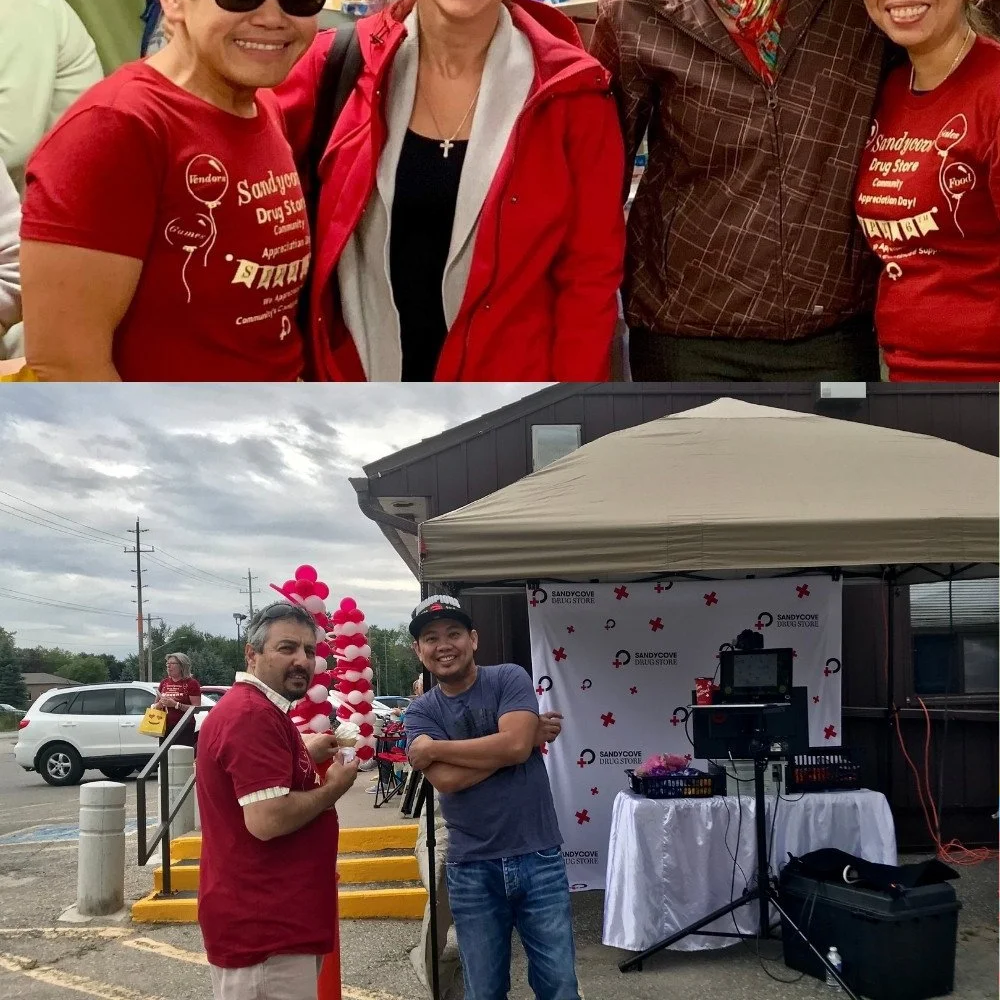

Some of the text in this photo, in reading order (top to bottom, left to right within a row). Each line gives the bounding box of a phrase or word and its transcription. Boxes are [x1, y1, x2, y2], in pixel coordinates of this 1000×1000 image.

[869, 158, 919, 176] Drug Store
[189, 174, 227, 184] Vendors
[949, 173, 972, 188] Food
[858, 194, 916, 209] Appreciation Day!
[256, 204, 285, 224] Drug
[274, 220, 305, 236] Community
